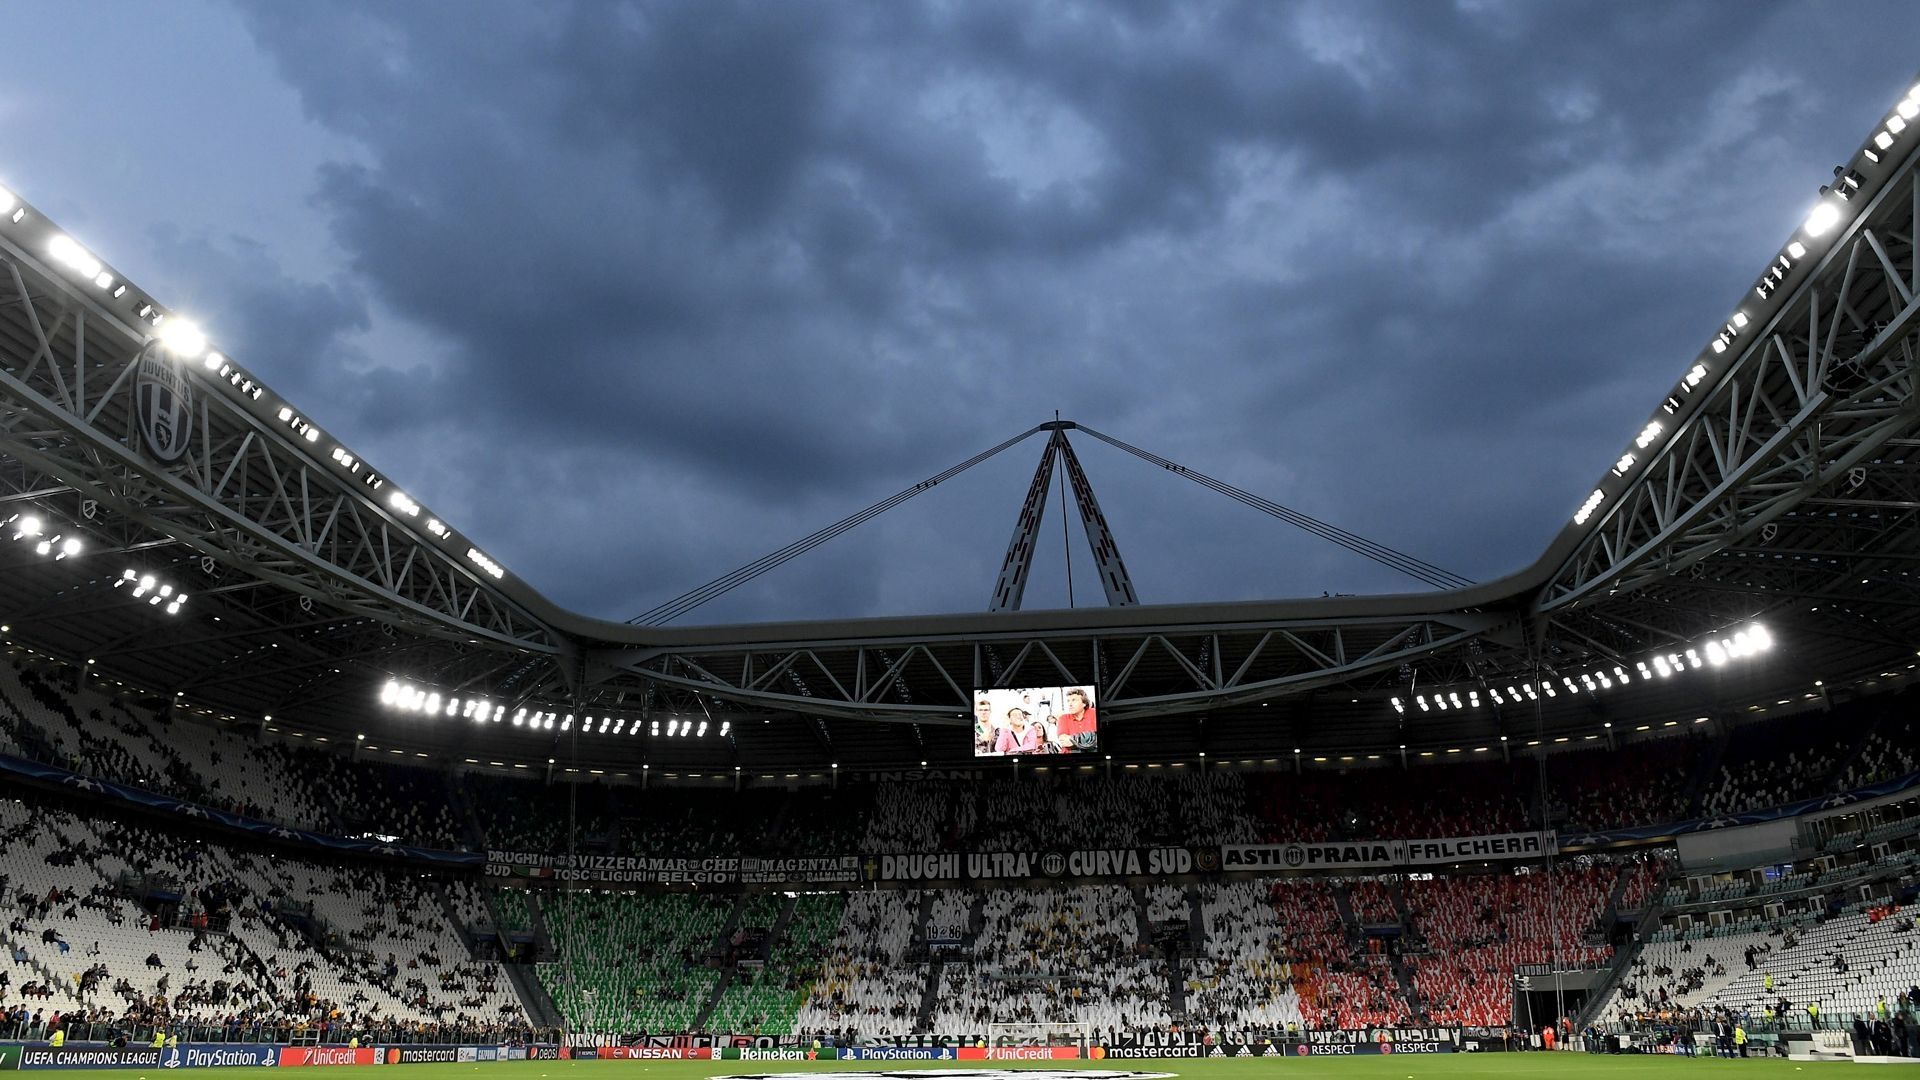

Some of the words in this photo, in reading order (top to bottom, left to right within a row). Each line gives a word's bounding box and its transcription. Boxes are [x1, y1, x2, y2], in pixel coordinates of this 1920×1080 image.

[143, 359, 190, 402] JUVENTUS
[869, 770, 984, 782] INSANI
[1409, 836, 1540, 859] FALCHERA
[487, 850, 539, 866] DRUGHI
[1225, 849, 1281, 865] ASTI
[1307, 845, 1391, 864] PRAIA
[567, 854, 648, 870] SVIZZERA
[760, 858, 839, 872] MAGENTA
[881, 853, 960, 880] DRUGHI
[1068, 850, 1142, 876] CURVA
[1149, 848, 1192, 875] SUD
[484, 864, 511, 877] SUD
[657, 871, 727, 884] BELGIO
[927, 925, 938, 939] 19
[949, 924, 961, 939] 86
[1520, 963, 1551, 976] ANDRIA
[539, 1047, 557, 1060] pepsi
[628, 1049, 682, 1059] NISSAN
[862, 1048, 932, 1060] PlayStation
[996, 1048, 1053, 1060] UniCredit
[1110, 1045, 1198, 1058] mastercard
[1312, 1044, 1356, 1055] RESPECT
[1395, 1042, 1440, 1053] RESPECT
[25, 1052, 53, 1065] UEFA
[57, 1051, 118, 1065] CHAMPIONS
[121, 1052, 157, 1065] LEAGUE
[186, 1049, 257, 1067] PlayStation
[313, 1048, 356, 1065] UniCredit
[402, 1048, 455, 1062] mastercard
[740, 1049, 804, 1061] Heineken
